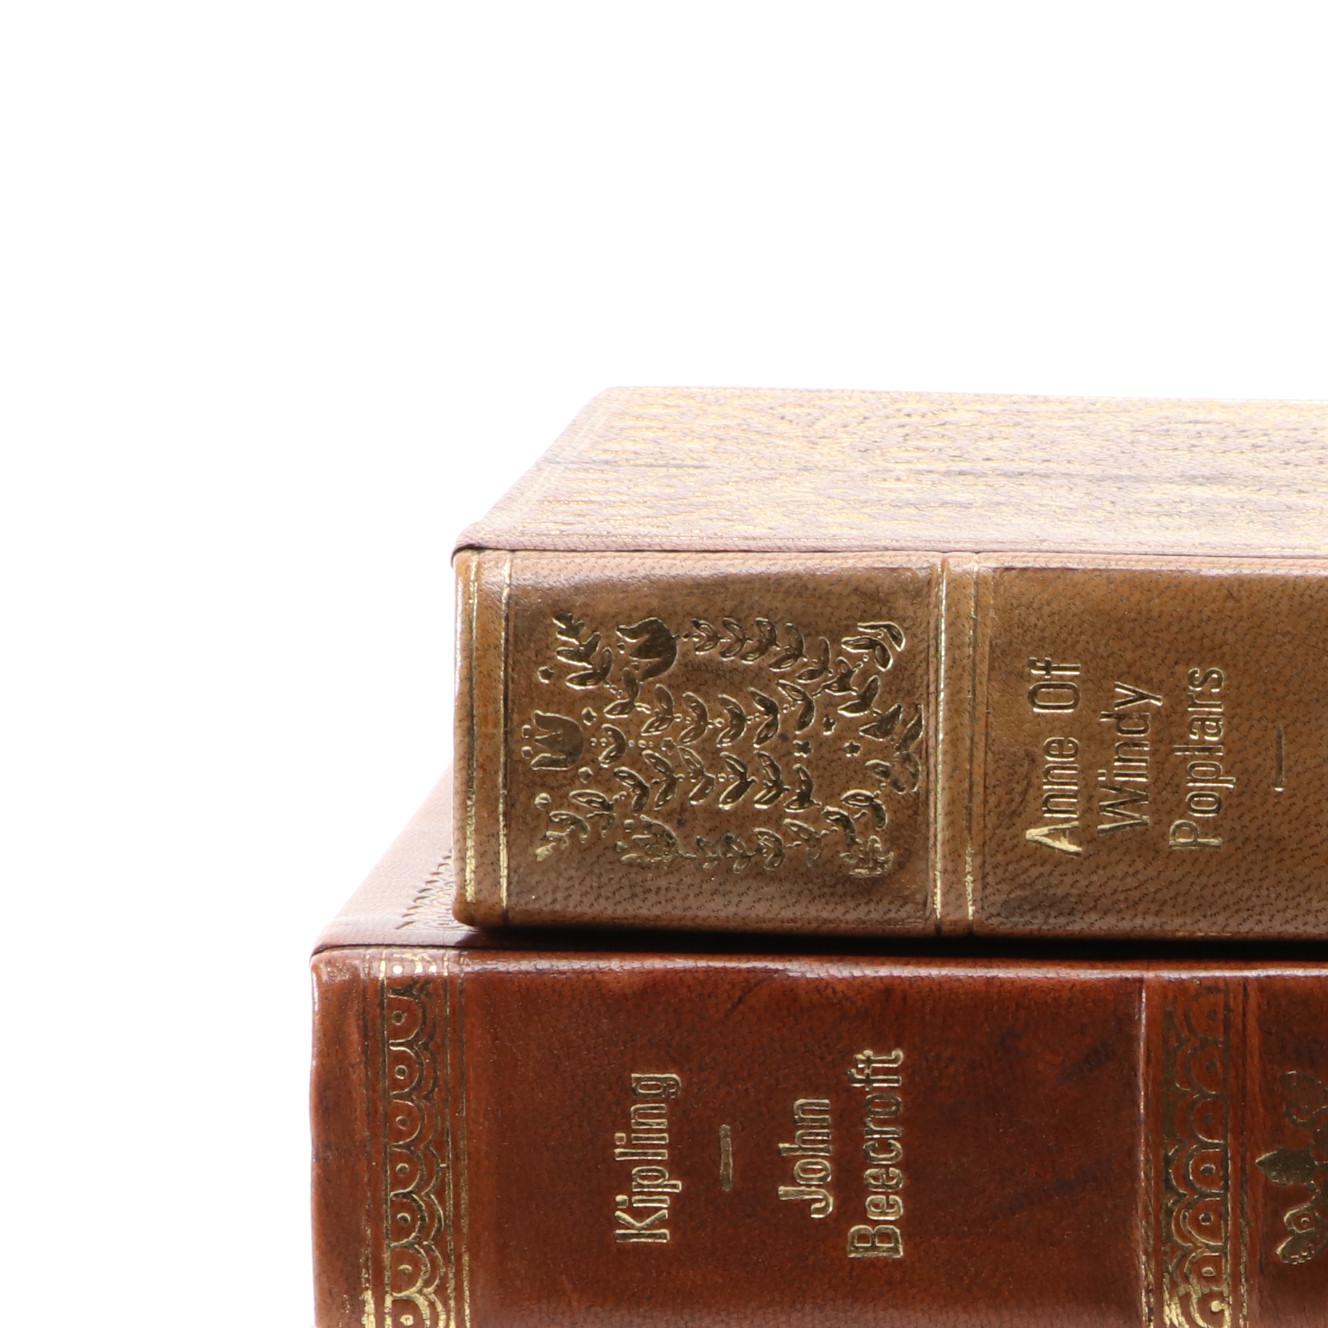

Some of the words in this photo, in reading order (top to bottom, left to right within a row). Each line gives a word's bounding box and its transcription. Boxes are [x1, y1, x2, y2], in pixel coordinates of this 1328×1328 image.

[1026, 656, 1081, 714] Of
[1097, 681, 1163, 833] Windy
[1169, 667, 1236, 850] Poplars
[1025, 736, 1083, 857] Anne
[614, 1073, 682, 1243] Kipling
[777, 1098, 833, 1218] John
[847, 1047, 904, 1258] Beecroft
